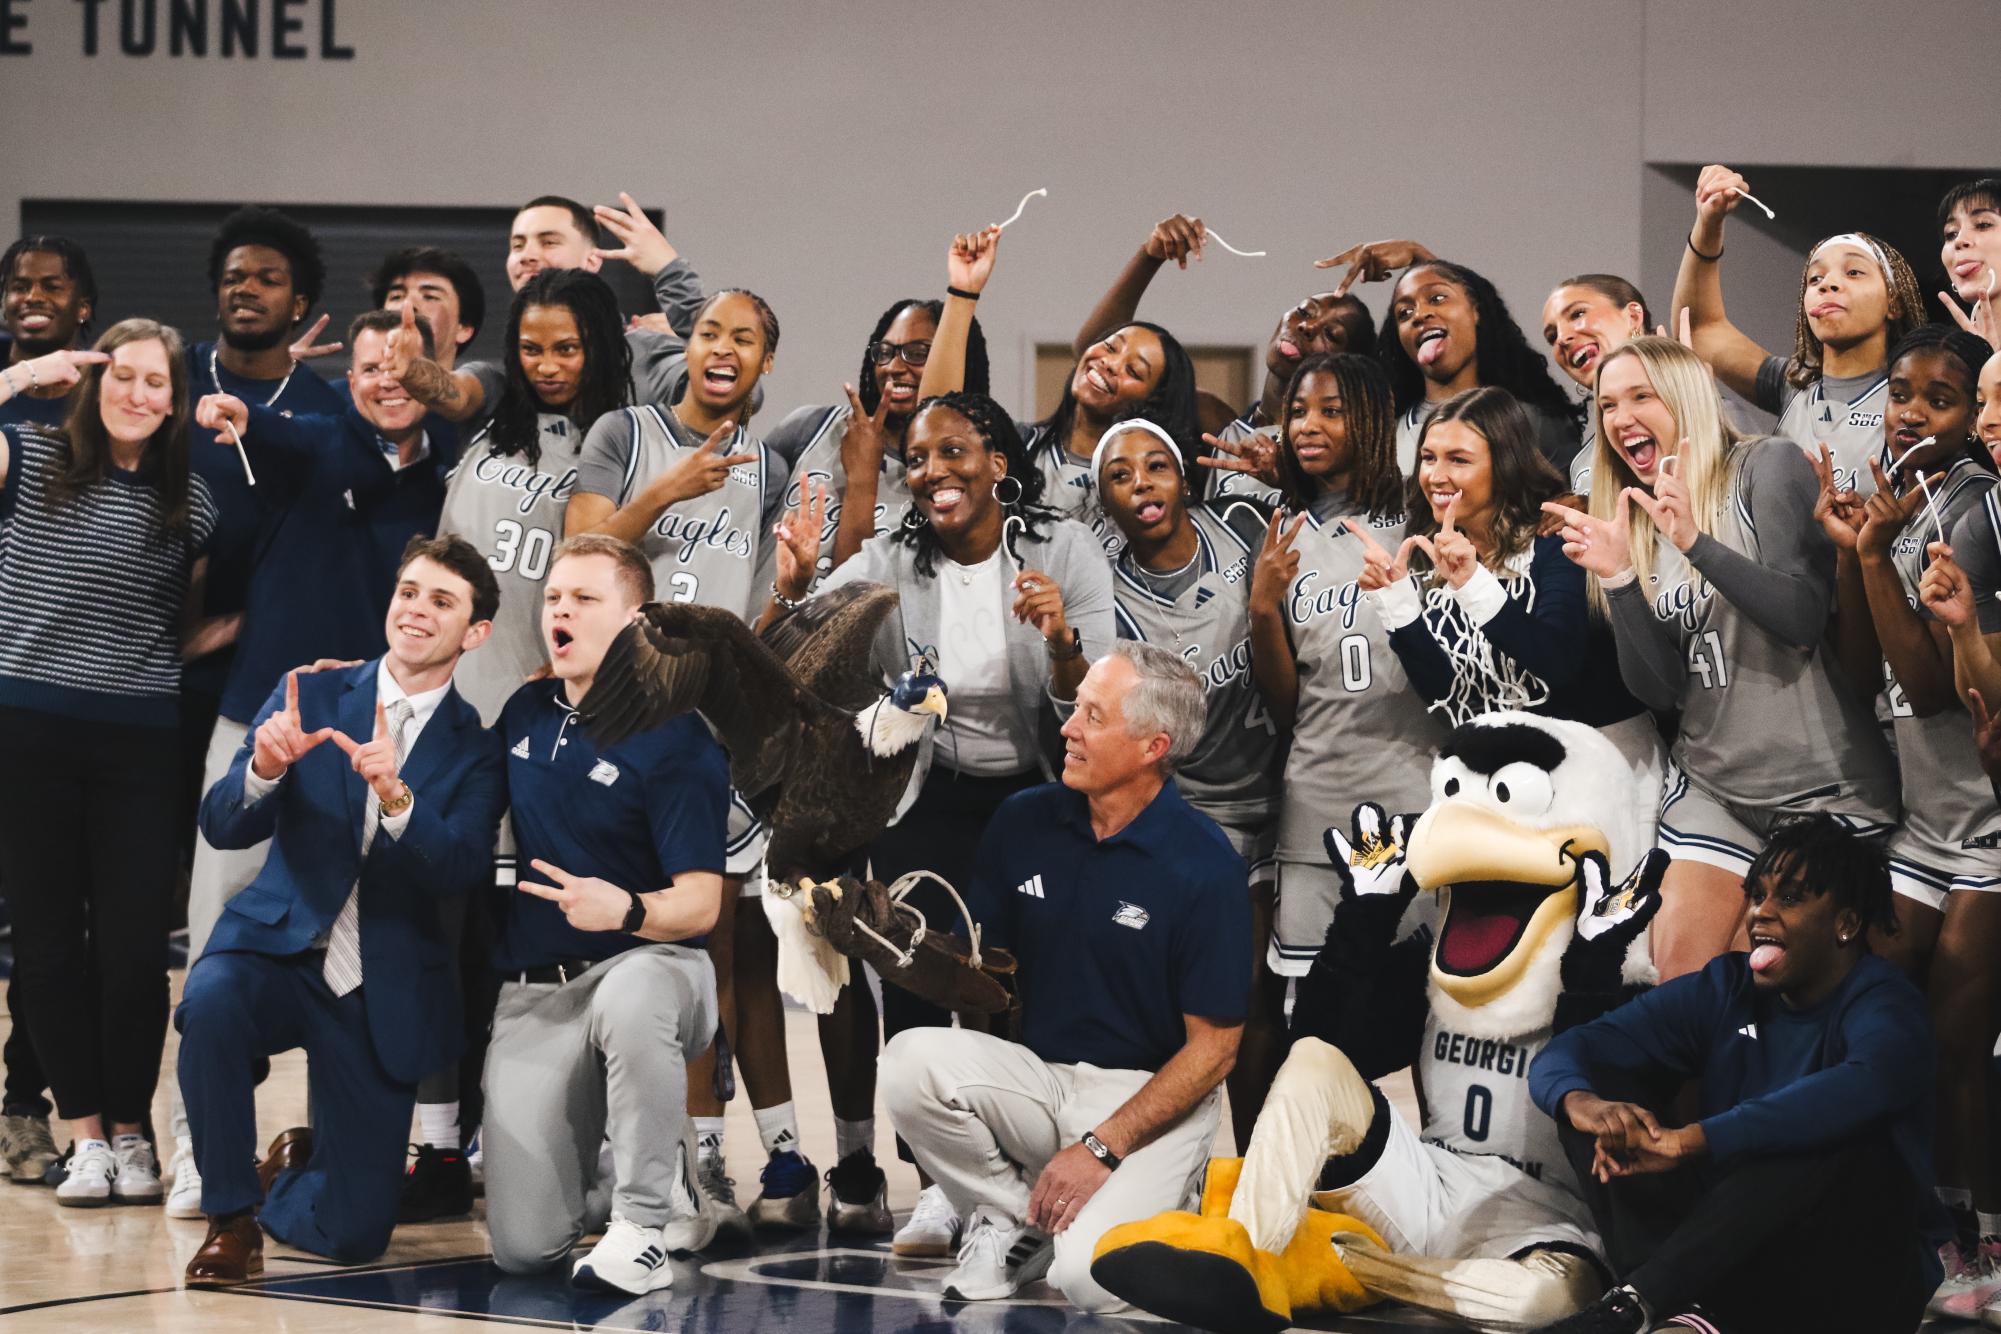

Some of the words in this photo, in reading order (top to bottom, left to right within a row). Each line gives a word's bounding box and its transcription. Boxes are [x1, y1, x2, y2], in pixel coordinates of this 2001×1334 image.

[0, 0, 33, 56] E
[76, 0, 356, 60] TUNNEL
[475, 449, 578, 514] Eagl
[487, 519, 554, 582] 30
[656, 507, 752, 564] agles
[1339, 633, 1373, 693] 0
[1687, 630, 1728, 689] 41
[1434, 1031, 1528, 1078] GEORGI
[1463, 1083, 1493, 1143] 0
